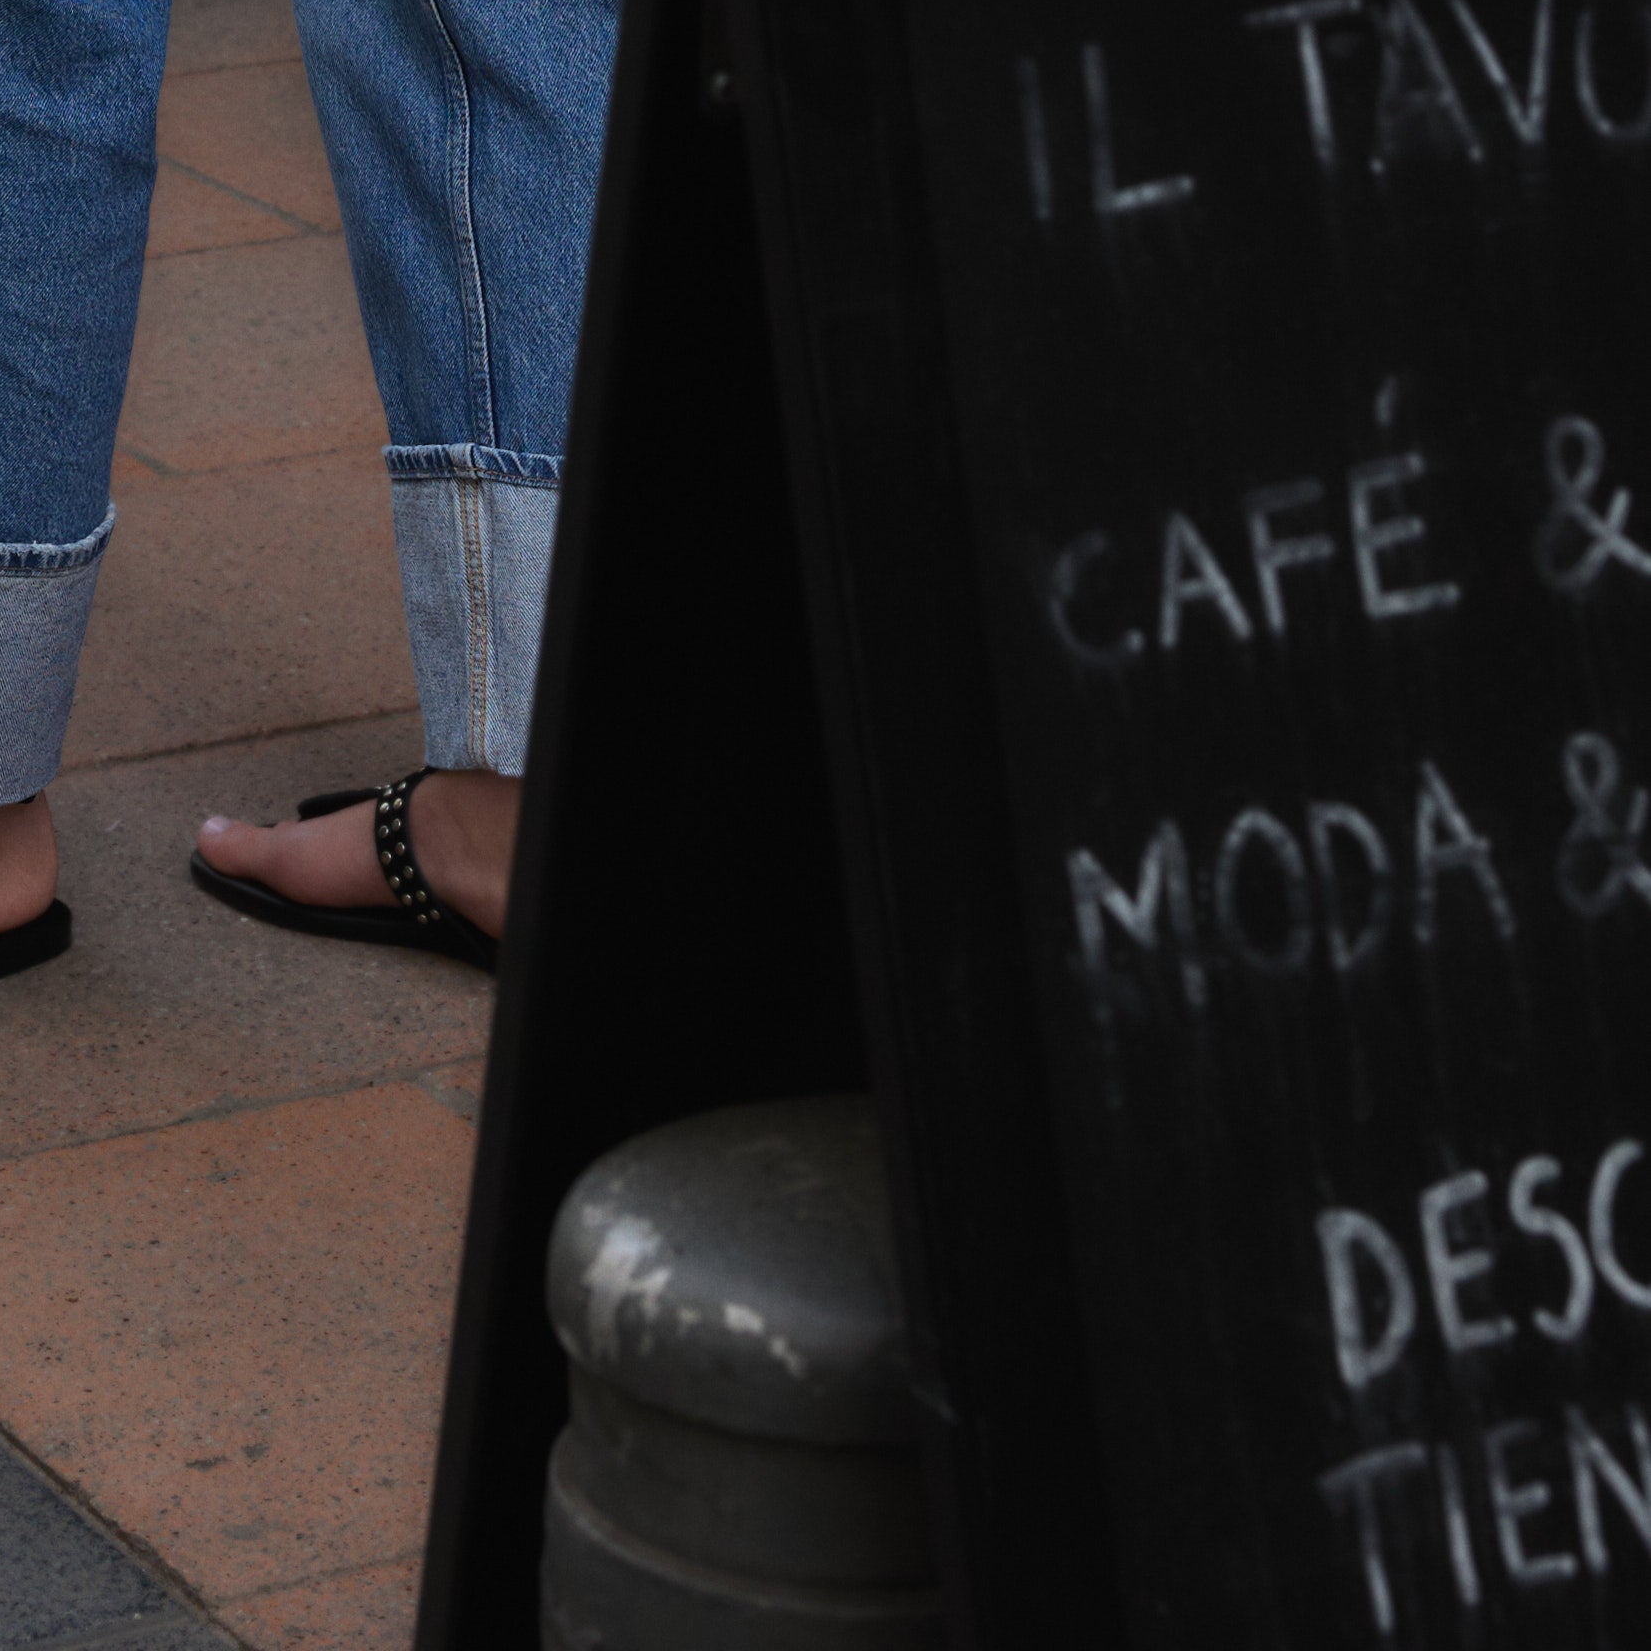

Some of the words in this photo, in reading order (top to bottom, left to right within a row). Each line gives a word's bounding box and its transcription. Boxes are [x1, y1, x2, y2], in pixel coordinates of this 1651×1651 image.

[1015, 39, 1196, 224] IL
[1048, 373, 1464, 667] CAFÉ
[1532, 412, 1651, 595] &
[1064, 755, 1518, 1007] MODA
[1555, 729, 1651, 921] &
[1315, 1135, 1651, 1389] DESC
[1315, 1401, 1651, 1637] TIEN
